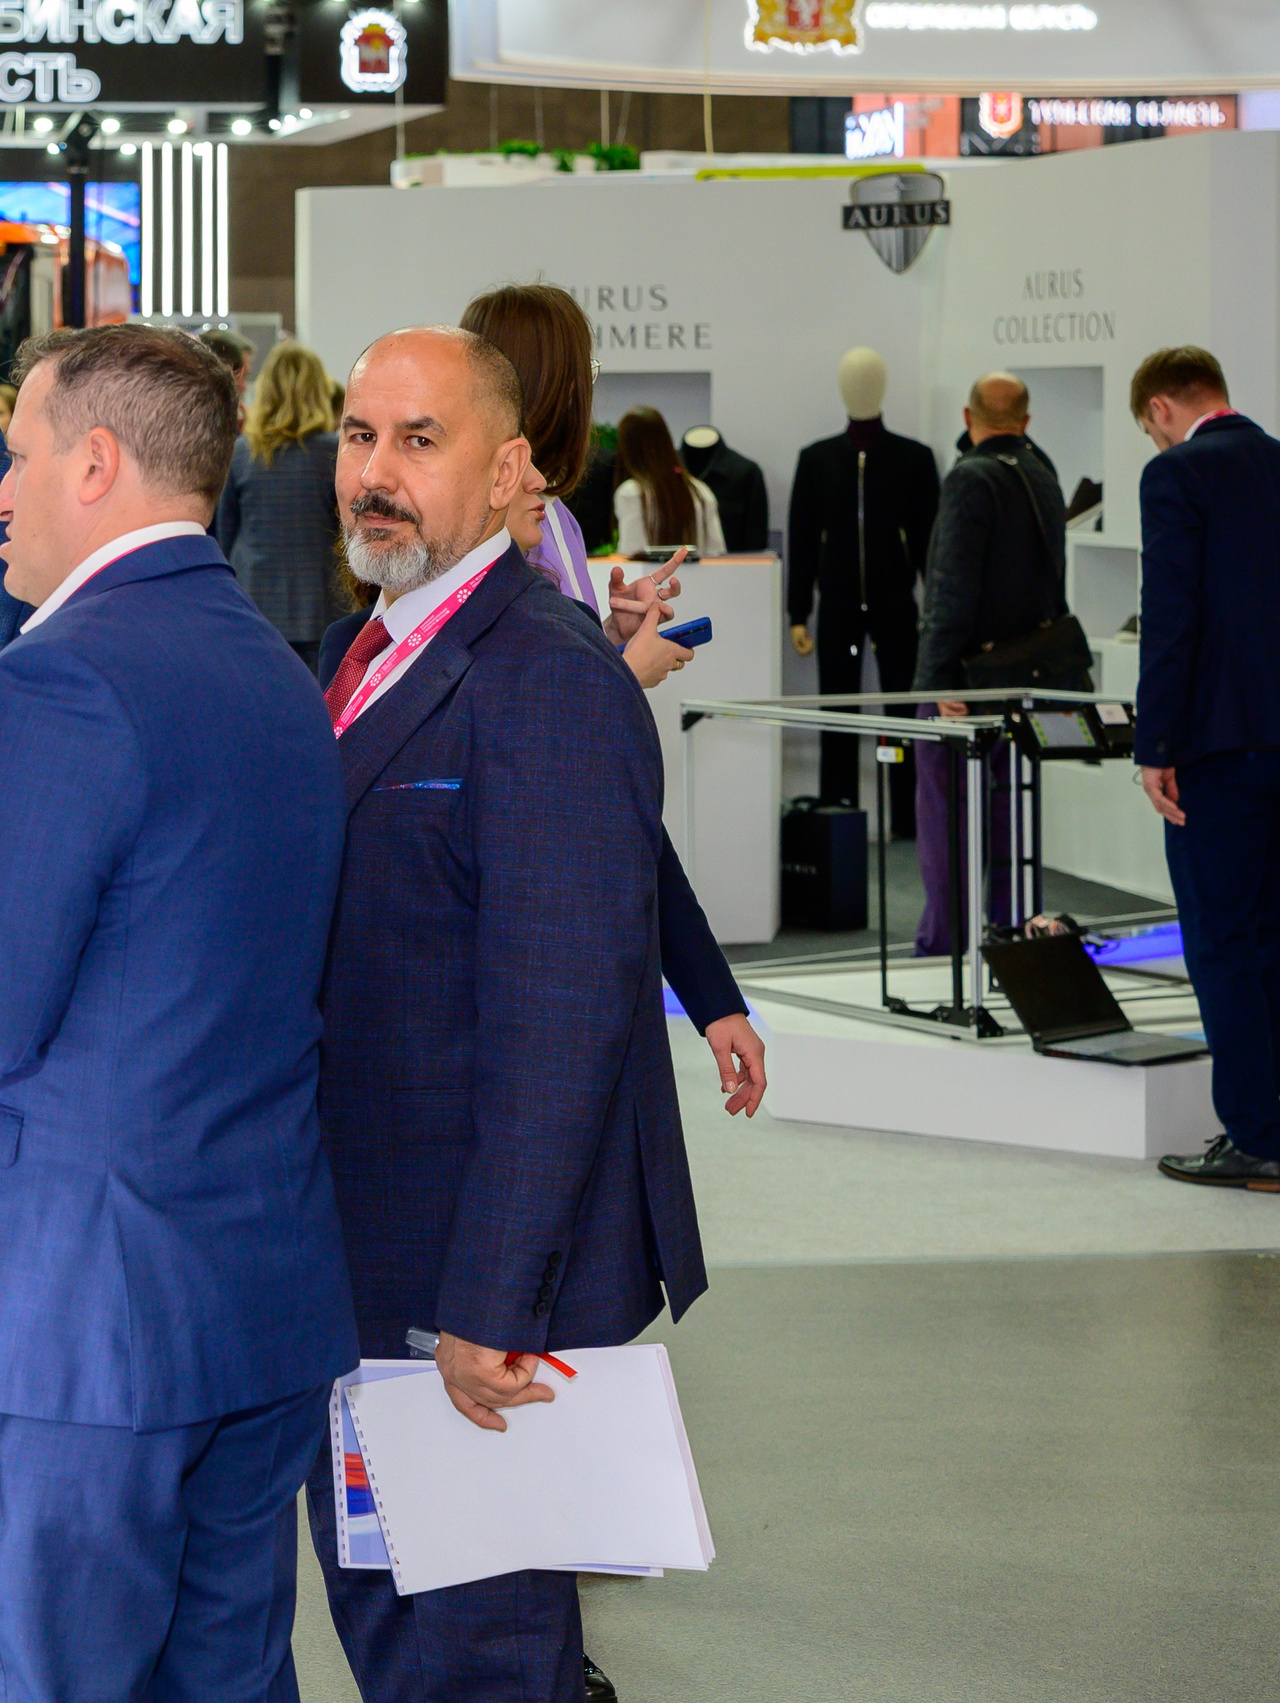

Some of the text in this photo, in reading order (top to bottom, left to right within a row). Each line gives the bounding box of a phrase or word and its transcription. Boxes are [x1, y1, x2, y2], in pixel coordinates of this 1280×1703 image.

[848, 201, 948, 228] AURUS
[570, 284, 669, 312] URUS
[1023, 267, 1085, 301] AURUS
[993, 310, 1117, 346] COLLECTION
